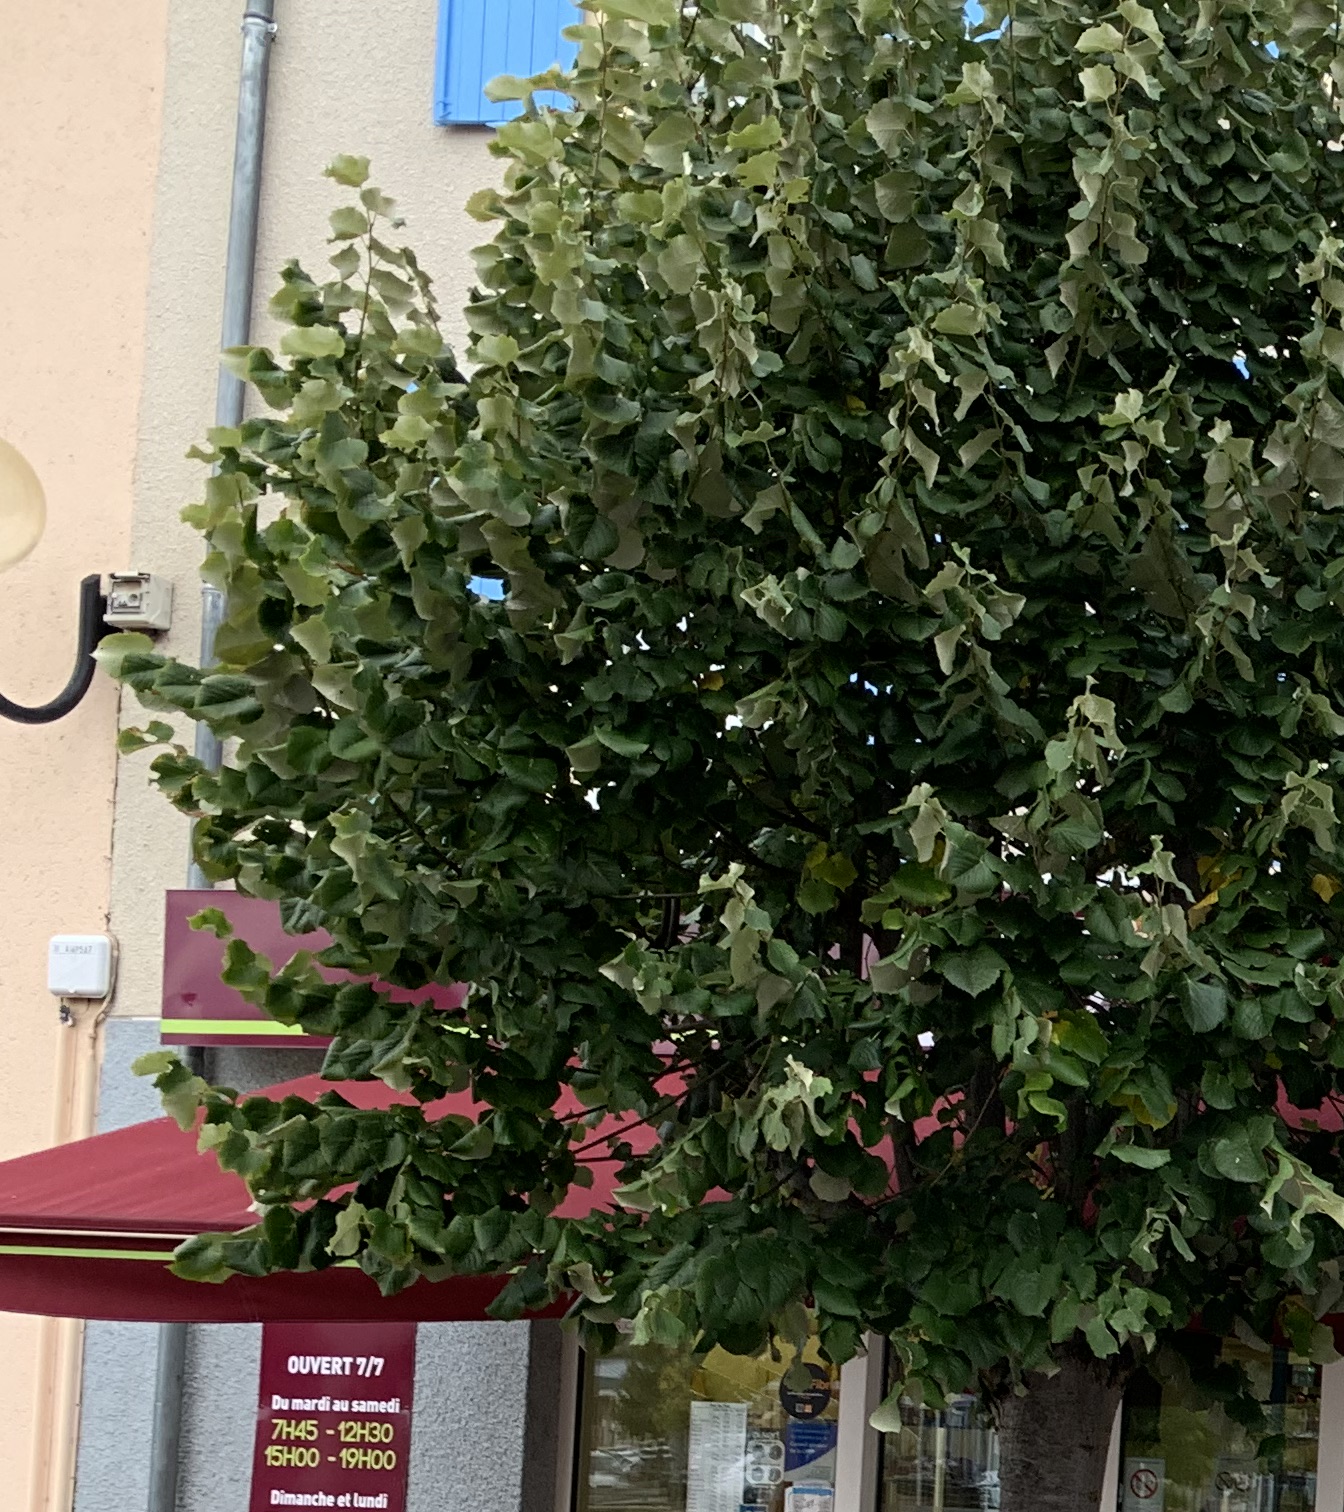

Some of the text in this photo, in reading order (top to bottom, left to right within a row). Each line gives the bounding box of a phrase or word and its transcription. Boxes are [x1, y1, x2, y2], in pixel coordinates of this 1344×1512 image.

[287, 1355, 384, 1378] OUVERT 7/7
[271, 1395, 400, 1413] Du mardi au samedi
[271, 1419, 318, 1441] 7H45
[264, 1445, 320, 1468] 15H00
[270, 1490, 388, 1508] Dimanche et lundi
